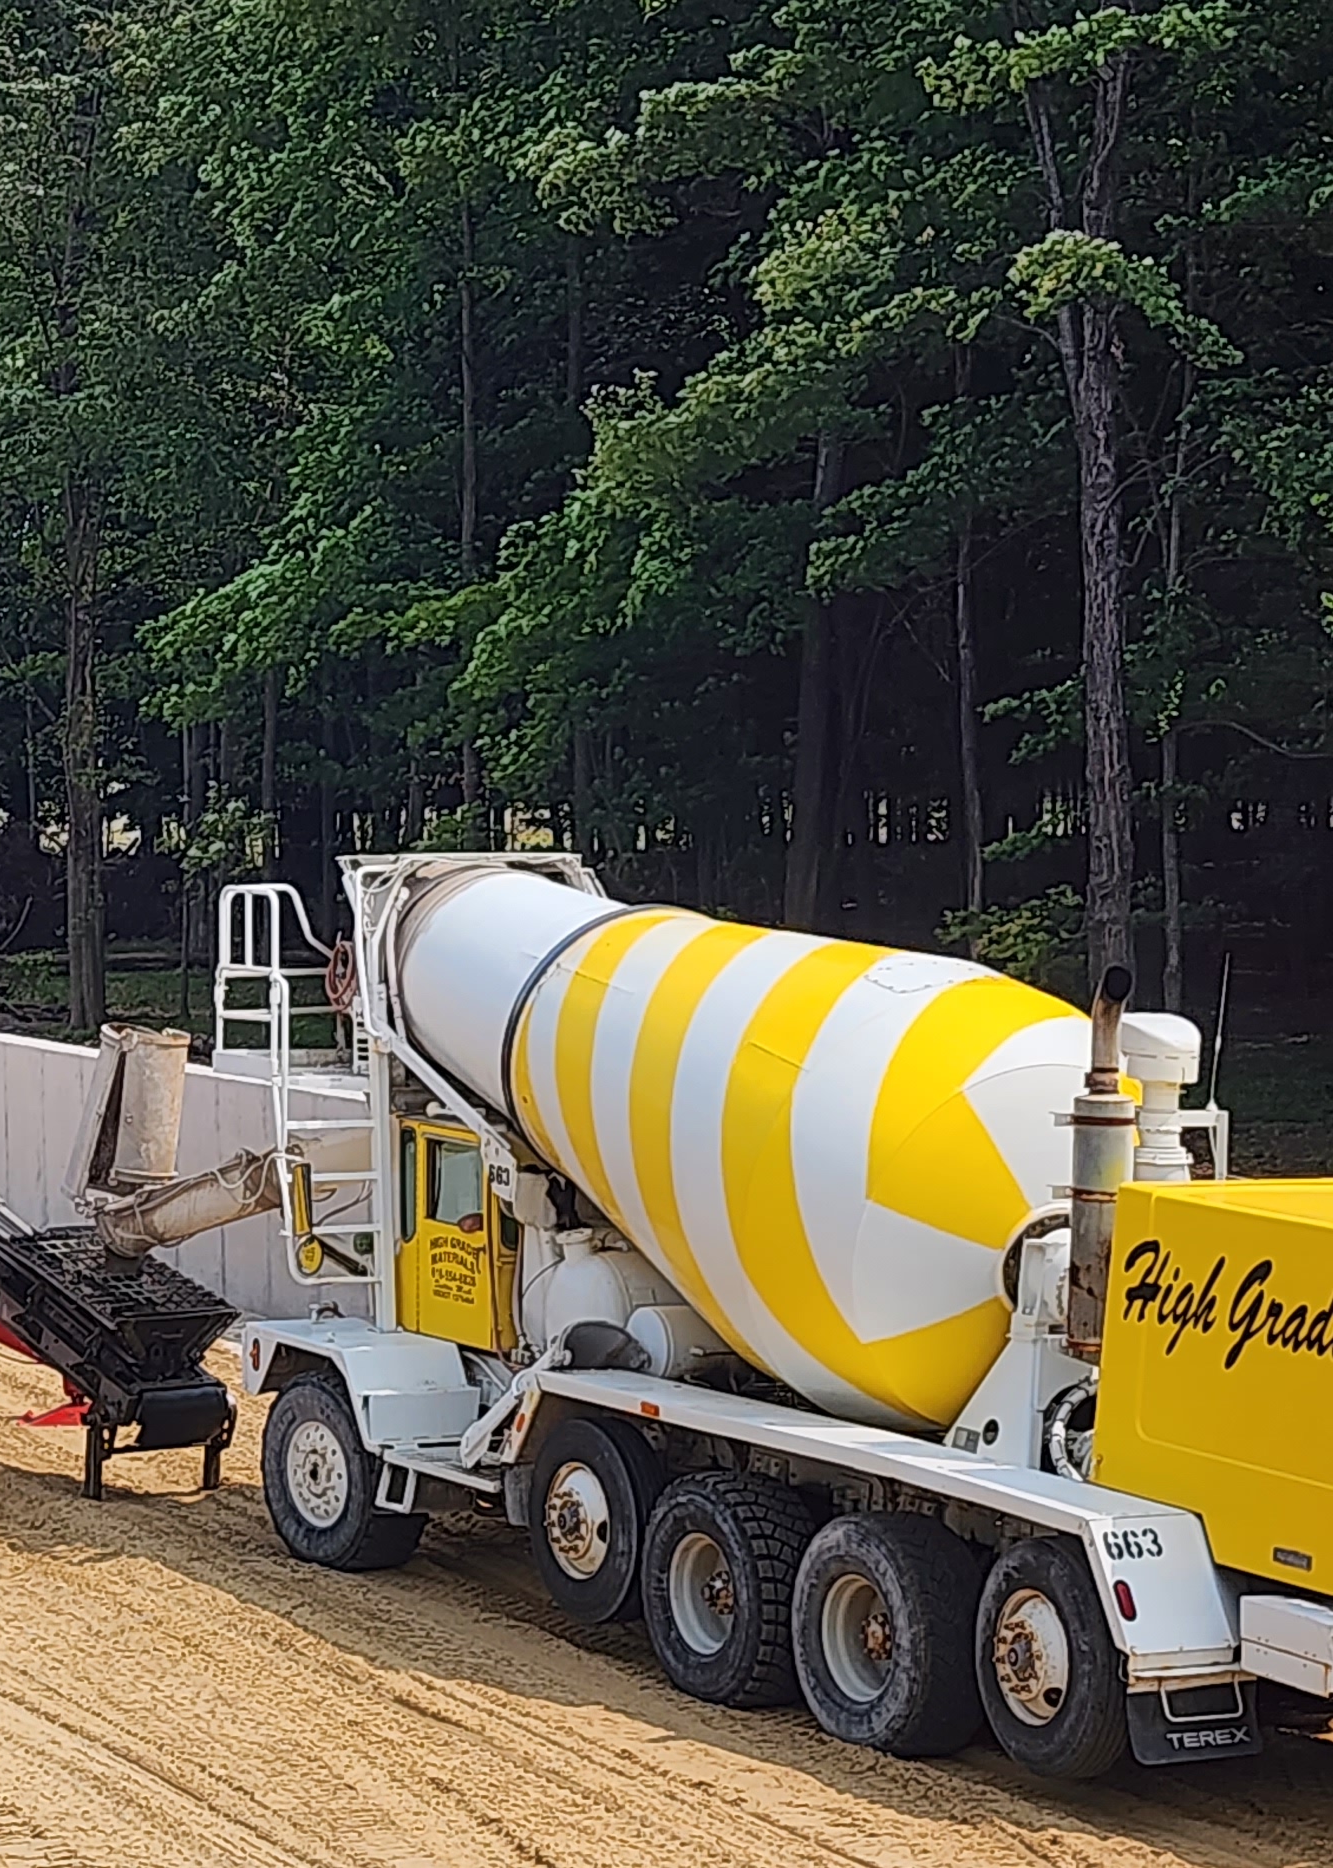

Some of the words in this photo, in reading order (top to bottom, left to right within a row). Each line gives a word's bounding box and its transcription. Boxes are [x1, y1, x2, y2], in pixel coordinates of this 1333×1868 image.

[488, 1163, 510, 1187] 663
[1122, 1239, 1226, 1357] High
[1102, 1527, 1164, 1561] 663
[1166, 1725, 1252, 1750] TEREX
